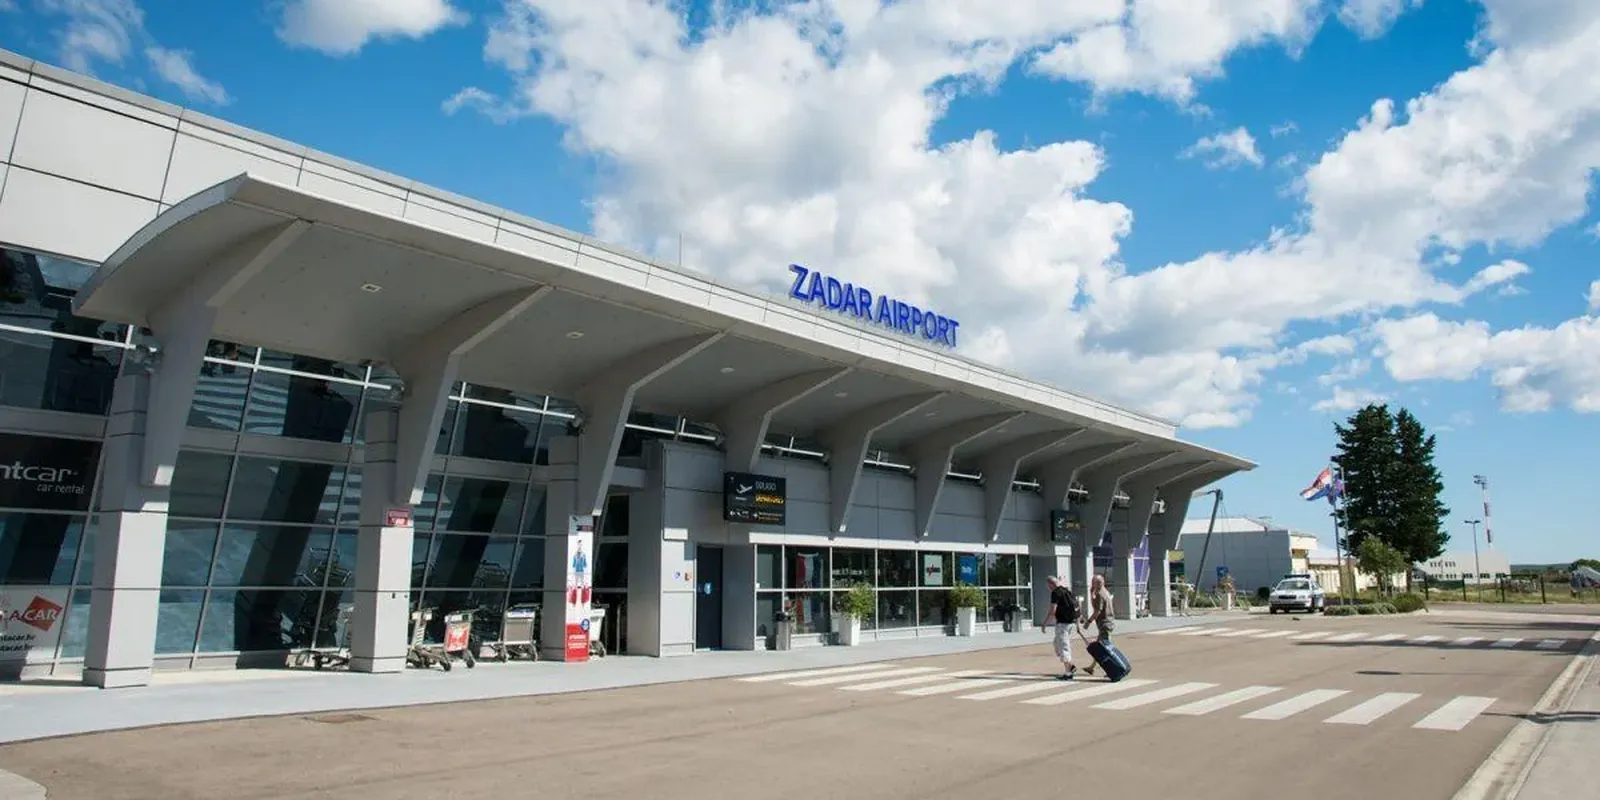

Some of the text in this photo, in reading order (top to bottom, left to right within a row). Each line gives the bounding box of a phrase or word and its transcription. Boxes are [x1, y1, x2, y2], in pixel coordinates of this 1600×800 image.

[788, 264, 959, 347] ZADAR AIRPORT
[37, 483, 84, 494] car rental
[23, 609, 56, 621] CAR
